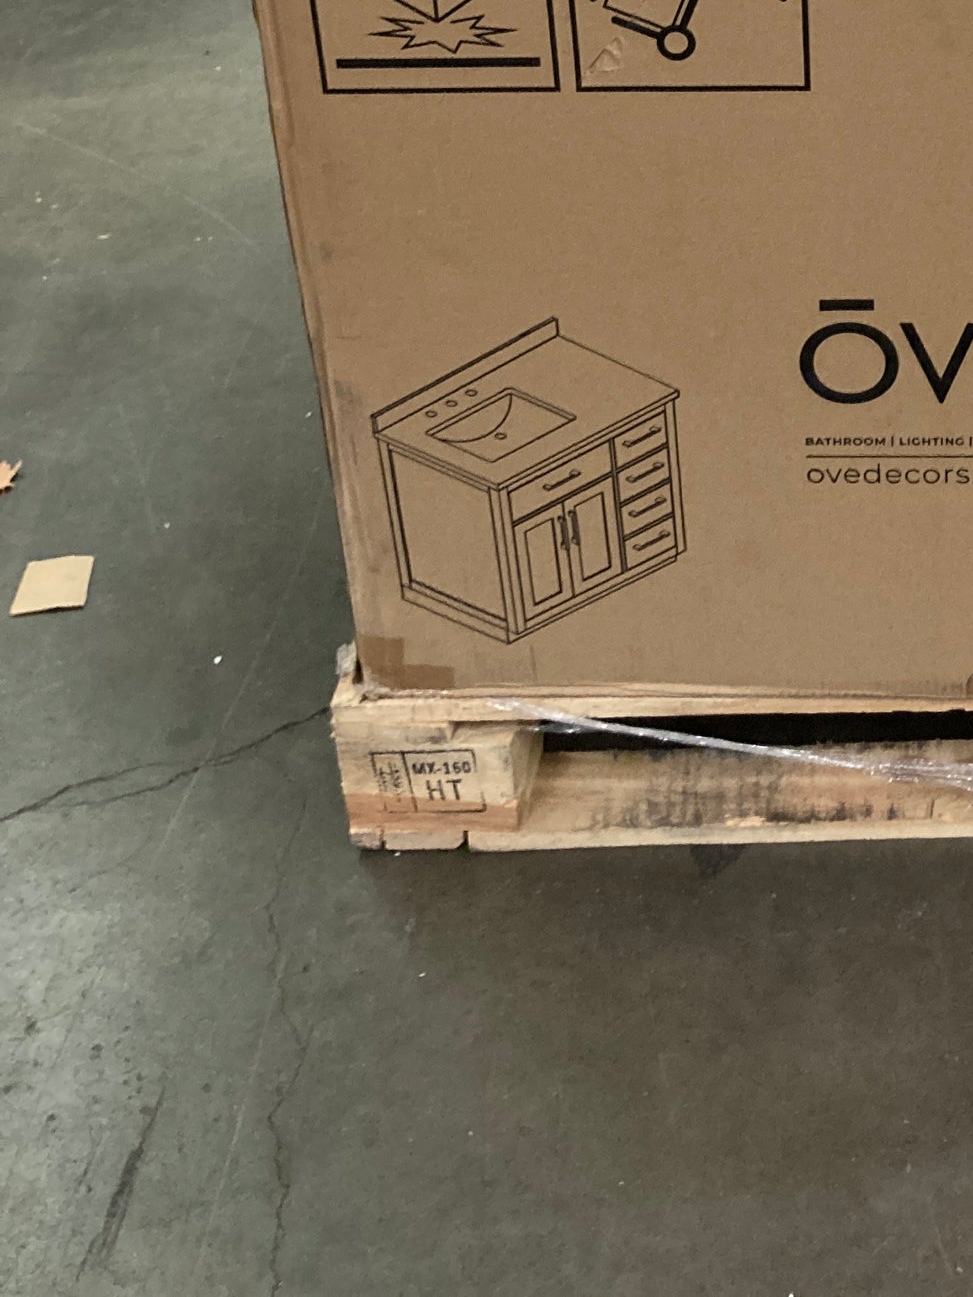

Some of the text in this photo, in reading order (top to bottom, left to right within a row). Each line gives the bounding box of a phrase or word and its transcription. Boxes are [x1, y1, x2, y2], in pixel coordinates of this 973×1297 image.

[805, 437, 885, 447] BATHROOM
[899, 437, 965, 447] LIGHTING
[426, 779, 462, 801] HT
